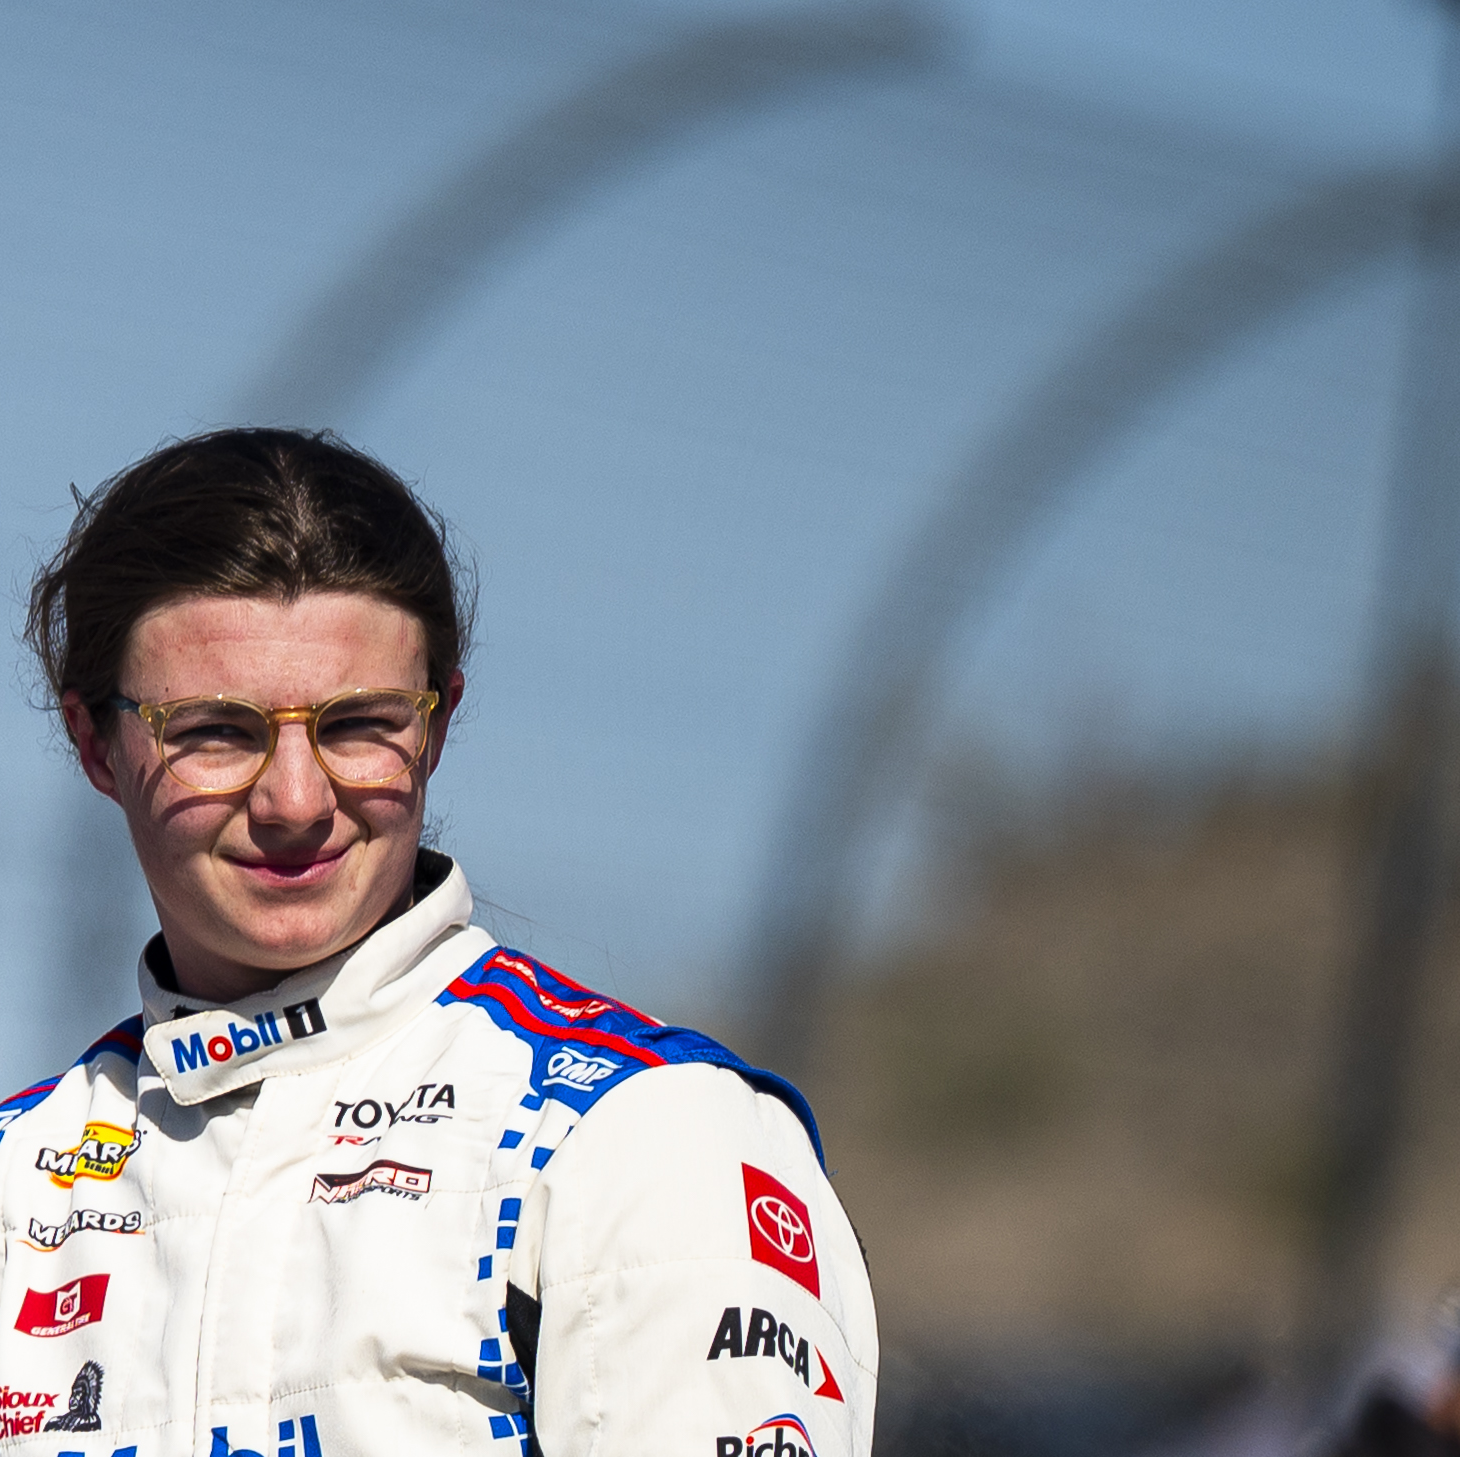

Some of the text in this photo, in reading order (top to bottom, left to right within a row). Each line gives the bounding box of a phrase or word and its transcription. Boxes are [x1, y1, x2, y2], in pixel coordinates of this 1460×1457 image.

[172, 1012, 282, 1073] Mobil
[548, 1052, 614, 1084] OMP
[334, 1083, 455, 1129] TOYTA
[707, 1307, 810, 1387] ARCA
